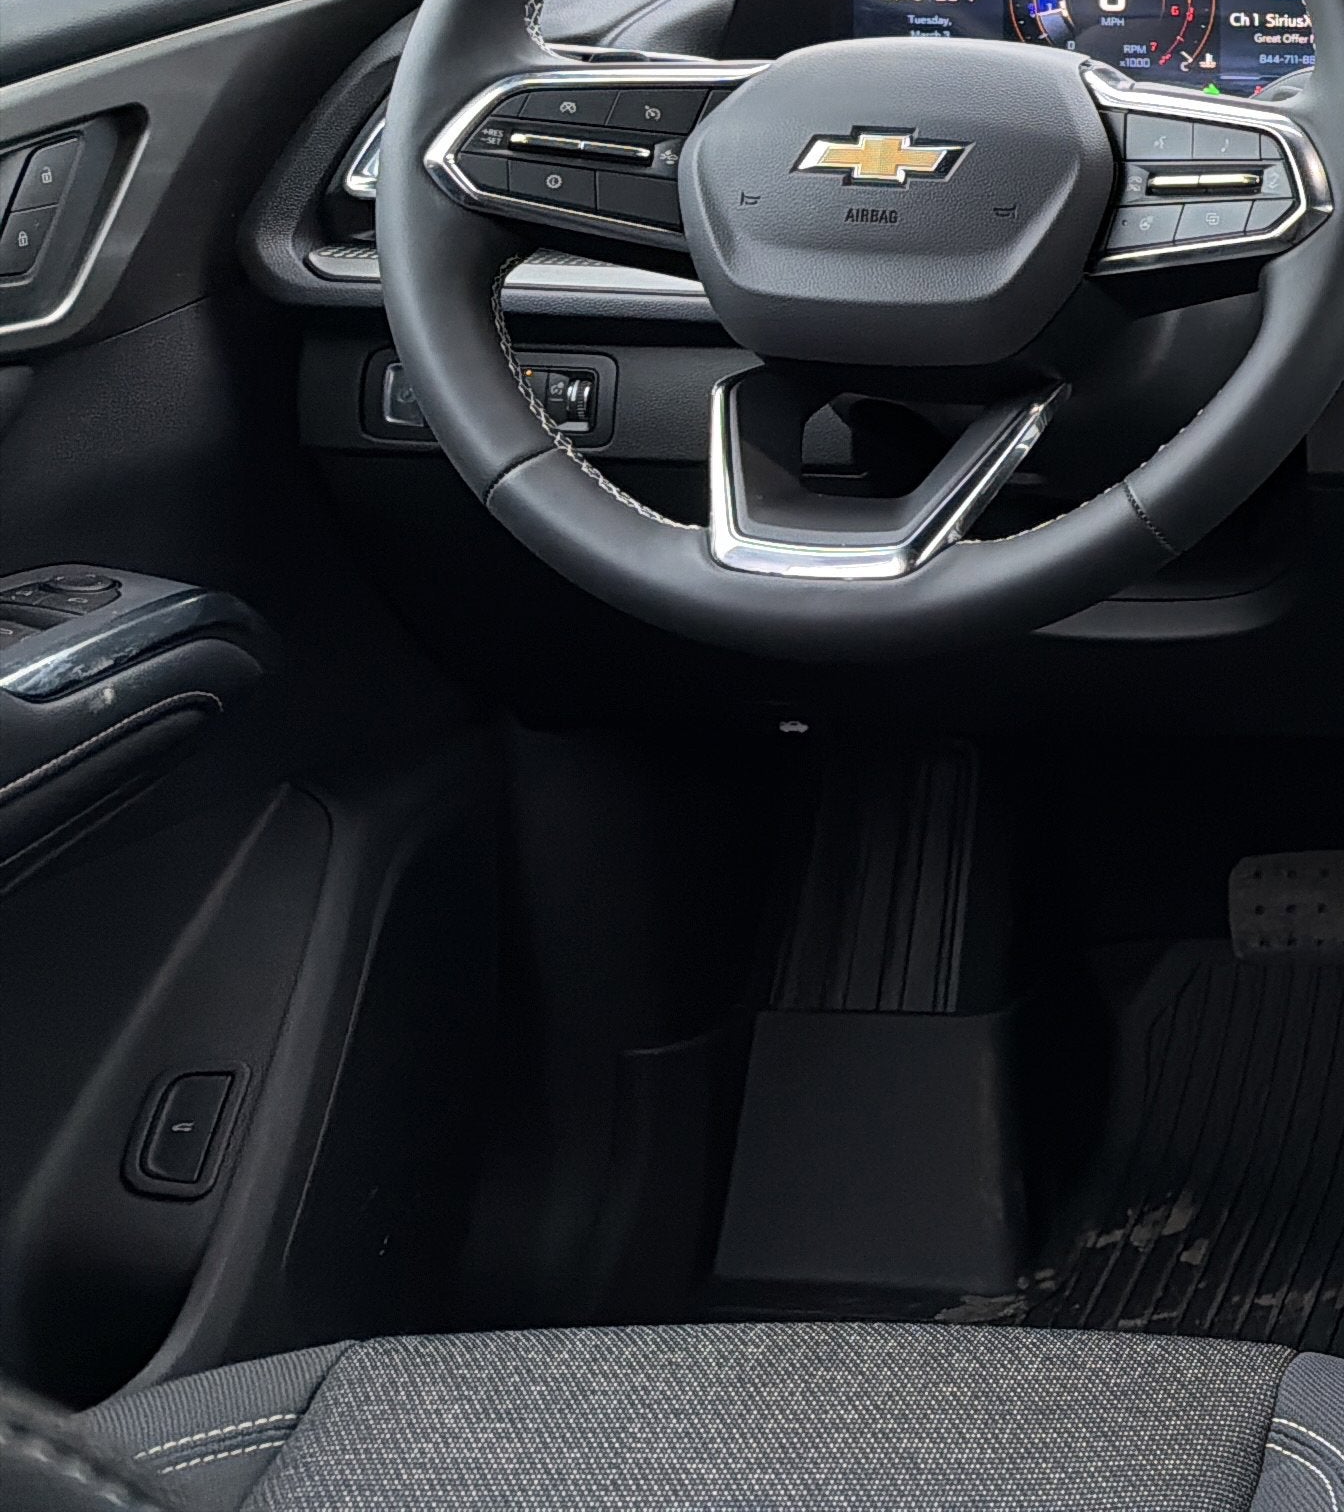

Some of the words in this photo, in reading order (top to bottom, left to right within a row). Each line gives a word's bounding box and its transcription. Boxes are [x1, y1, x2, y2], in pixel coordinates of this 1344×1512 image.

[1171, 6, 1180, 16] 6
[907, 15, 952, 27] Tuesday,
[1101, 17, 1125, 26] MPH
[1229, 12, 1250, 27] Ch
[1253, 13, 1259, 27] 1
[1265, 13, 1312, 28] SiriusX
[1254, 33, 1282, 43] Great
[1282, 34, 1309, 44] Offer
[1123, 44, 1147, 54] RPM
[1150, 42, 1158, 52] 7
[1120, 58, 1151, 68] x1000
[844, 208, 898, 224] AIRBAG
